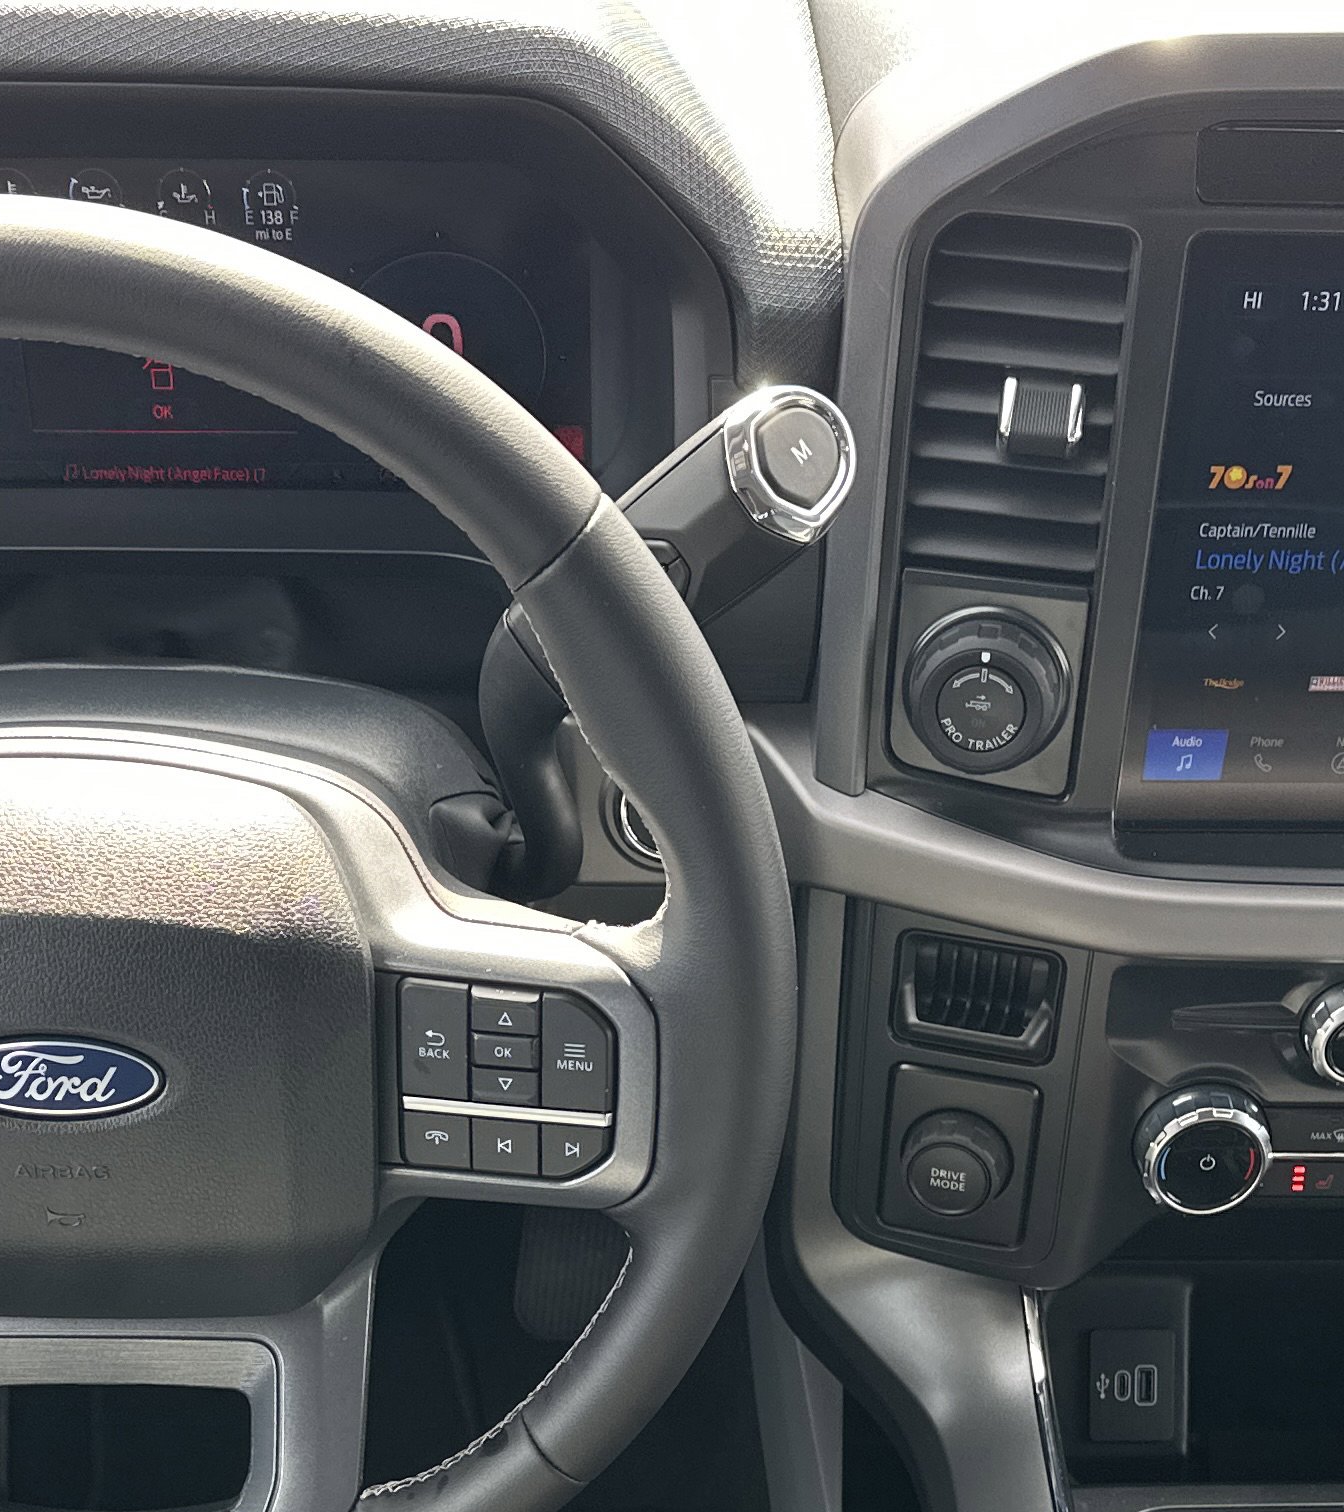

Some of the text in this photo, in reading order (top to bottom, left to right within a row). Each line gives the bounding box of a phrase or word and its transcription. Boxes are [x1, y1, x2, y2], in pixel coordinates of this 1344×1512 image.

[204, 210, 216, 225] H
[246, 210, 254, 225] E
[261, 210, 283, 225] 138
[290, 210, 298, 225] F
[256, 228, 293, 241] mi to E
[1243, 290, 1343, 312] HI 1:31
[1253, 390, 1312, 408] Sources
[152, 404, 174, 419] OK
[790, 438, 813, 465] M
[128, 466, 165, 483] Night
[1275, 465, 1293, 489] 7
[1198, 522, 1317, 541] Captain/Tennille
[1195, 549, 1263, 573] Lonely
[1268, 549, 1325, 574] Night
[1190, 585, 1225, 601] Ch. 7
[941, 717, 1019, 751] PRO TRAILER
[1172, 735, 1203, 748] Audio
[1250, 735, 1285, 748] Phone
[418, 1046, 450, 1059] BACK
[494, 1046, 512, 1058] OK
[557, 1059, 593, 1072] MENU
[1311, 1131, 1332, 1141] MAX
[14, 1163, 111, 1180] AIRBAG
[931, 1168, 966, 1182] DRIVE
[930, 1177, 965, 1192] MODE
